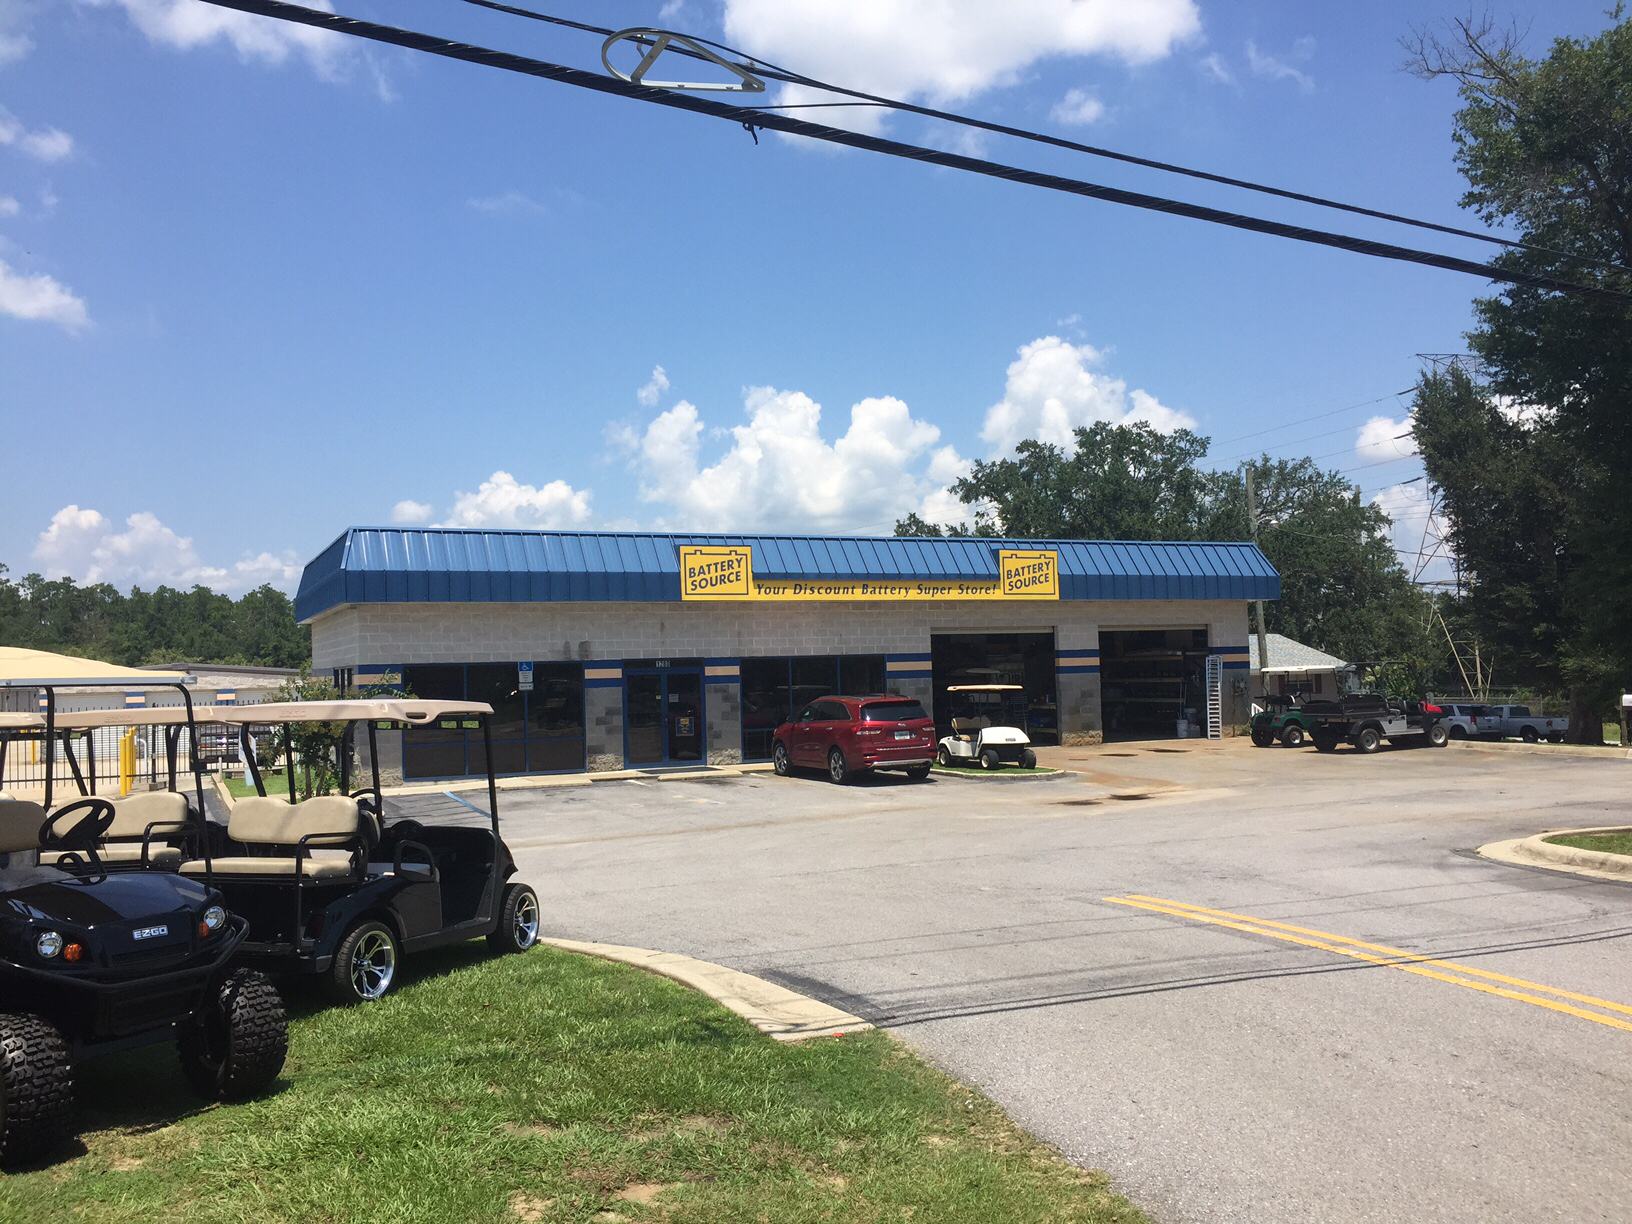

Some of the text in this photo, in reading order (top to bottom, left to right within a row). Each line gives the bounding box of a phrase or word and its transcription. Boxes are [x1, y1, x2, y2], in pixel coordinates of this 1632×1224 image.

[688, 557, 743, 579] BATTERY
[1006, 560, 1051, 580] BATTERY
[690, 570, 741, 592] SOURCE
[756, 583, 997, 598] Your Discount Battery Super Store!
[1008, 573, 1050, 591] SOURCE
